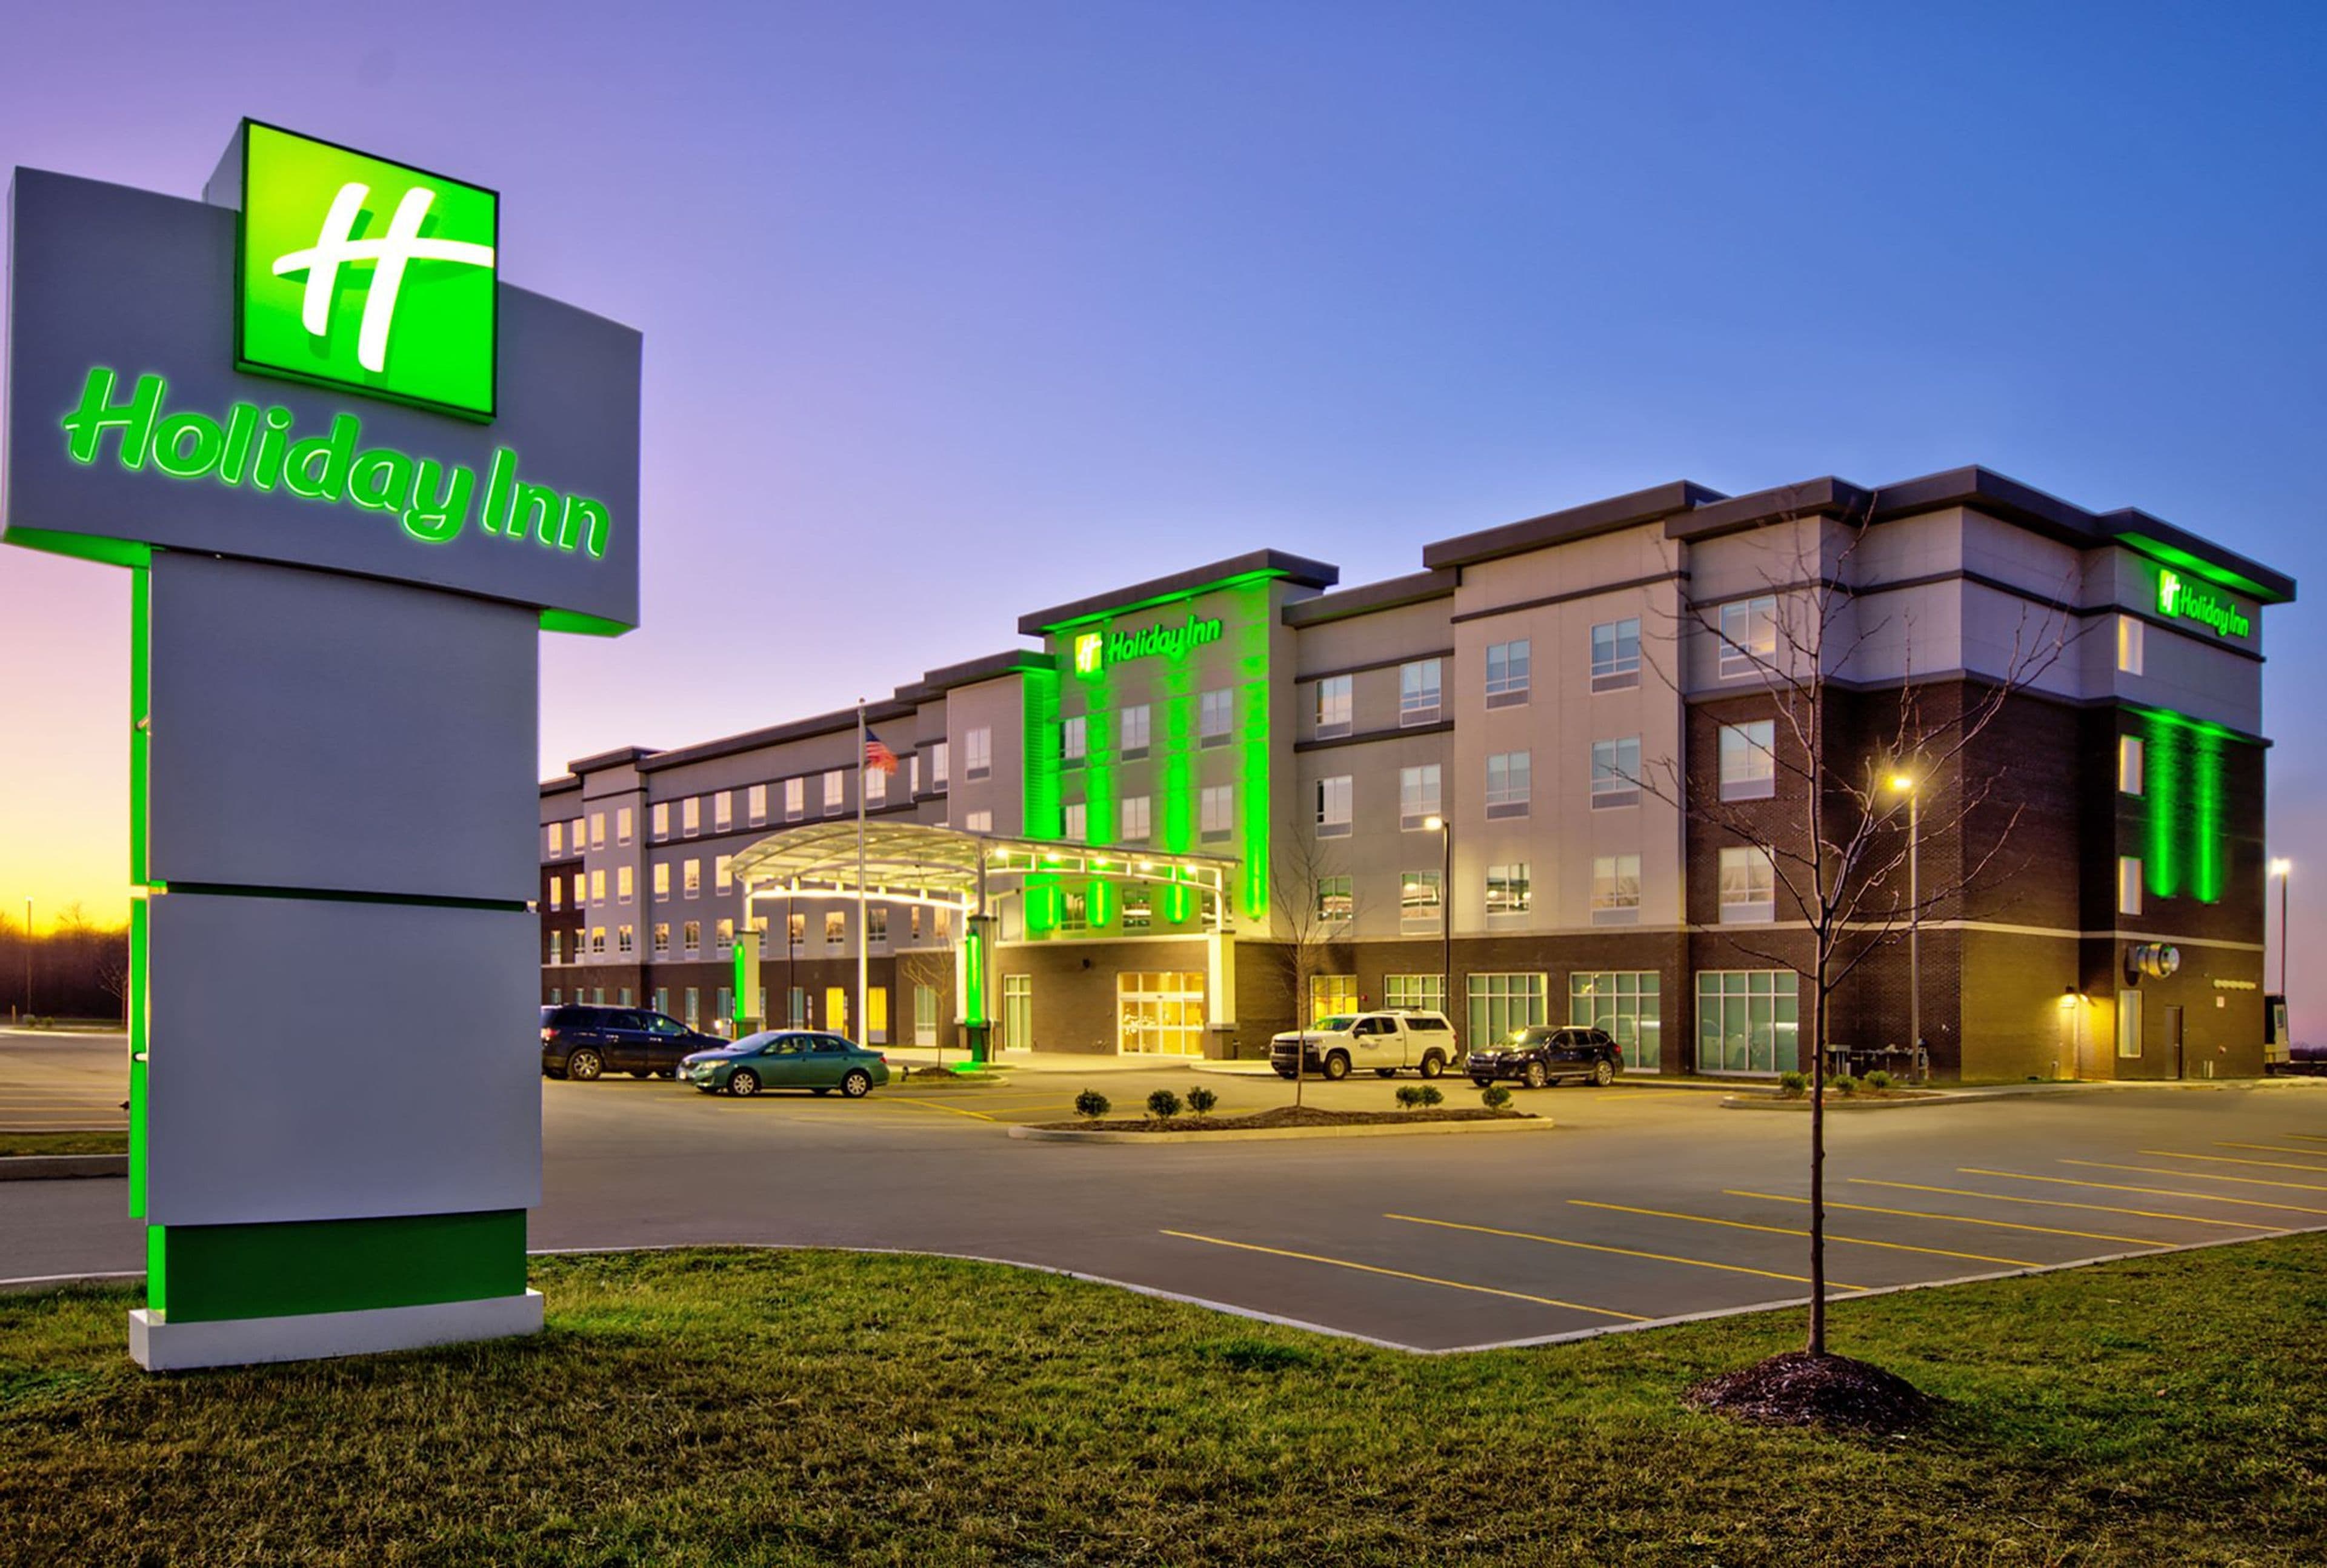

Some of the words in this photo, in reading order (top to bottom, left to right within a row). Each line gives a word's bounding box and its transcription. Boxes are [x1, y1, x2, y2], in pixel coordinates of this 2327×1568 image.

[62, 367, 475, 542] Holiday
[482, 445, 610, 559] Inn
[2181, 585, 2230, 636] Holiday
[2230, 603, 2249, 637] Inn
[1108, 623, 1186, 663] Holiday
[1187, 615, 1222, 645] Inn
